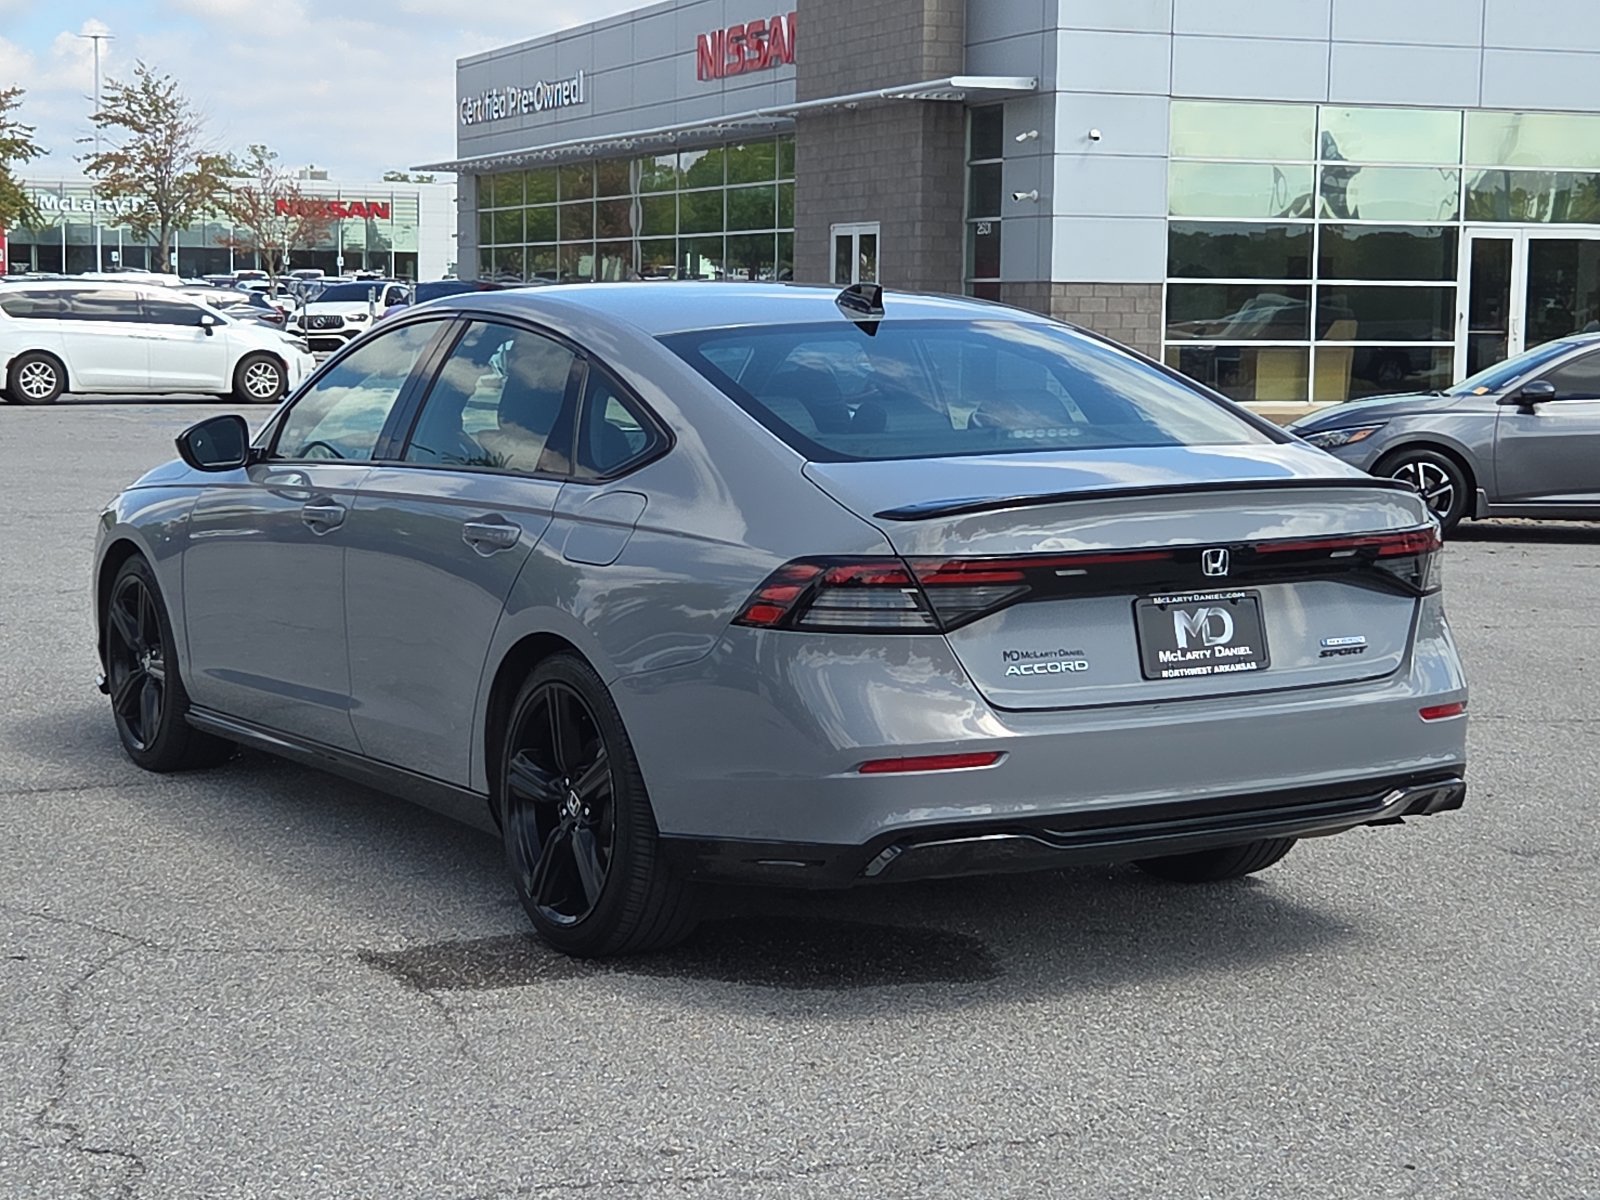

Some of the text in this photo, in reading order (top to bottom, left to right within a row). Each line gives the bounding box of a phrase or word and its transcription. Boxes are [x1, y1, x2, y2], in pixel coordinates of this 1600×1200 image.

[460, 70, 583, 125] Certified Pre-Owned
[1214, 646, 1252, 657] DANIEL
[1005, 660, 1089, 676] ACCORD
[1162, 661, 1257, 678] NORTHWEST ARKANSAS
